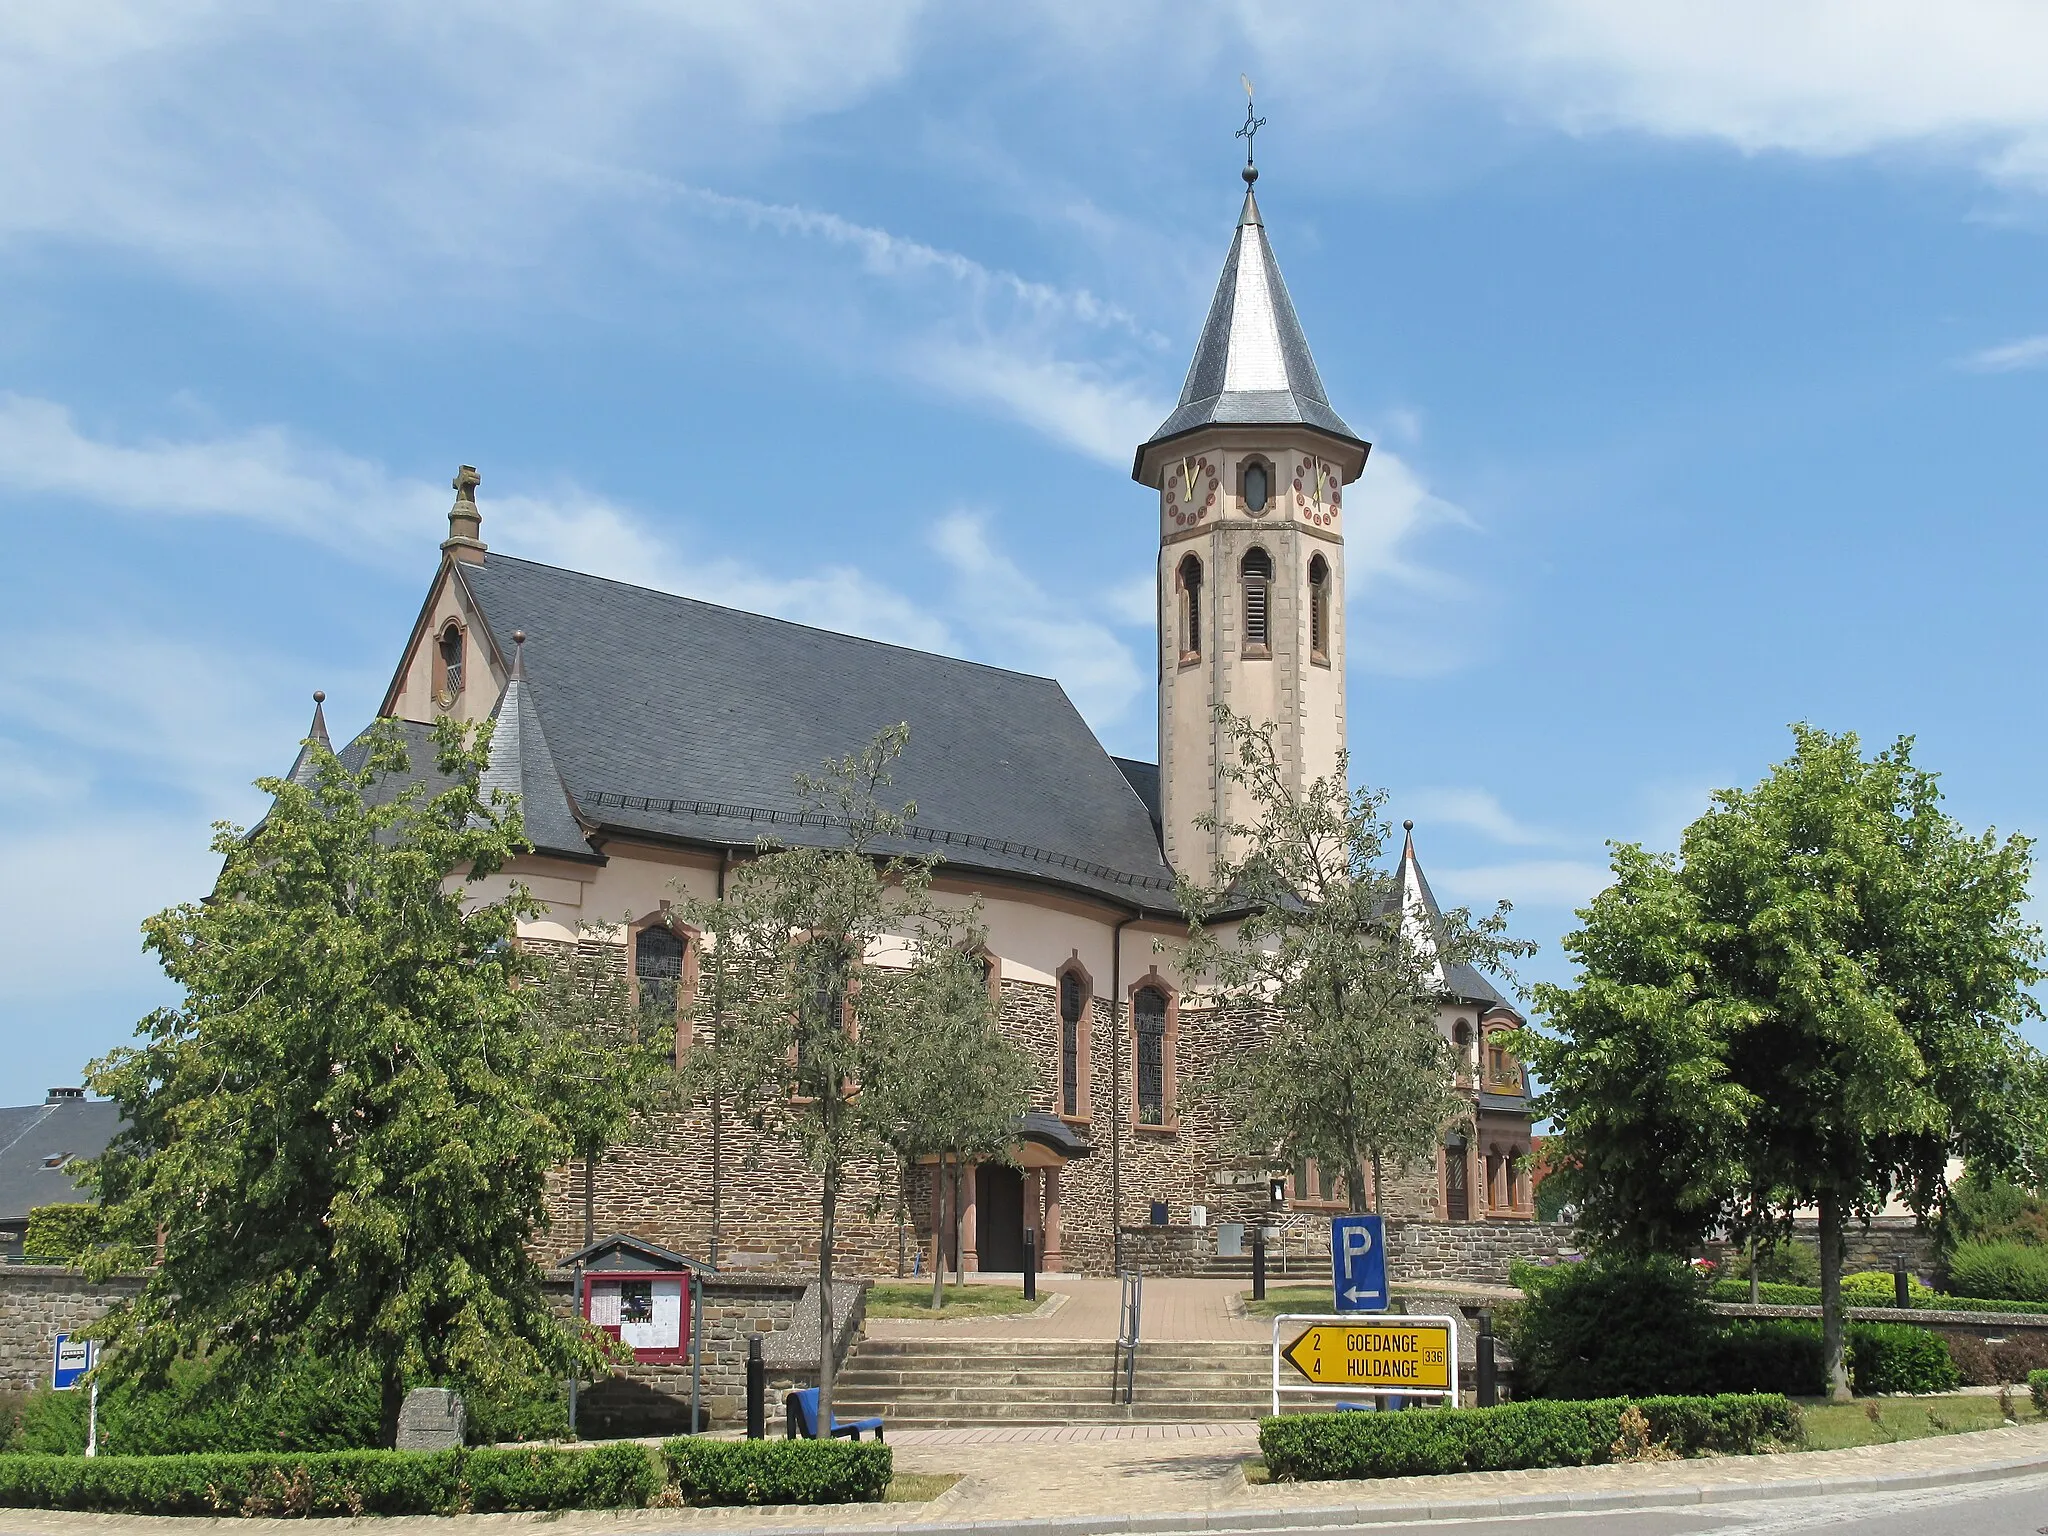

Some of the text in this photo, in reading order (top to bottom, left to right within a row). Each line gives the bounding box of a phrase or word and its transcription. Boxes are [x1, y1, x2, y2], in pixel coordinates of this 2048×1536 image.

[1342, 1226, 1372, 1279] P
[1313, 1333, 1419, 1353] 2 GOEDANGE
[1424, 1350, 1443, 1363] 336
[1313, 1358, 1419, 1378] 4 HULDANGE
